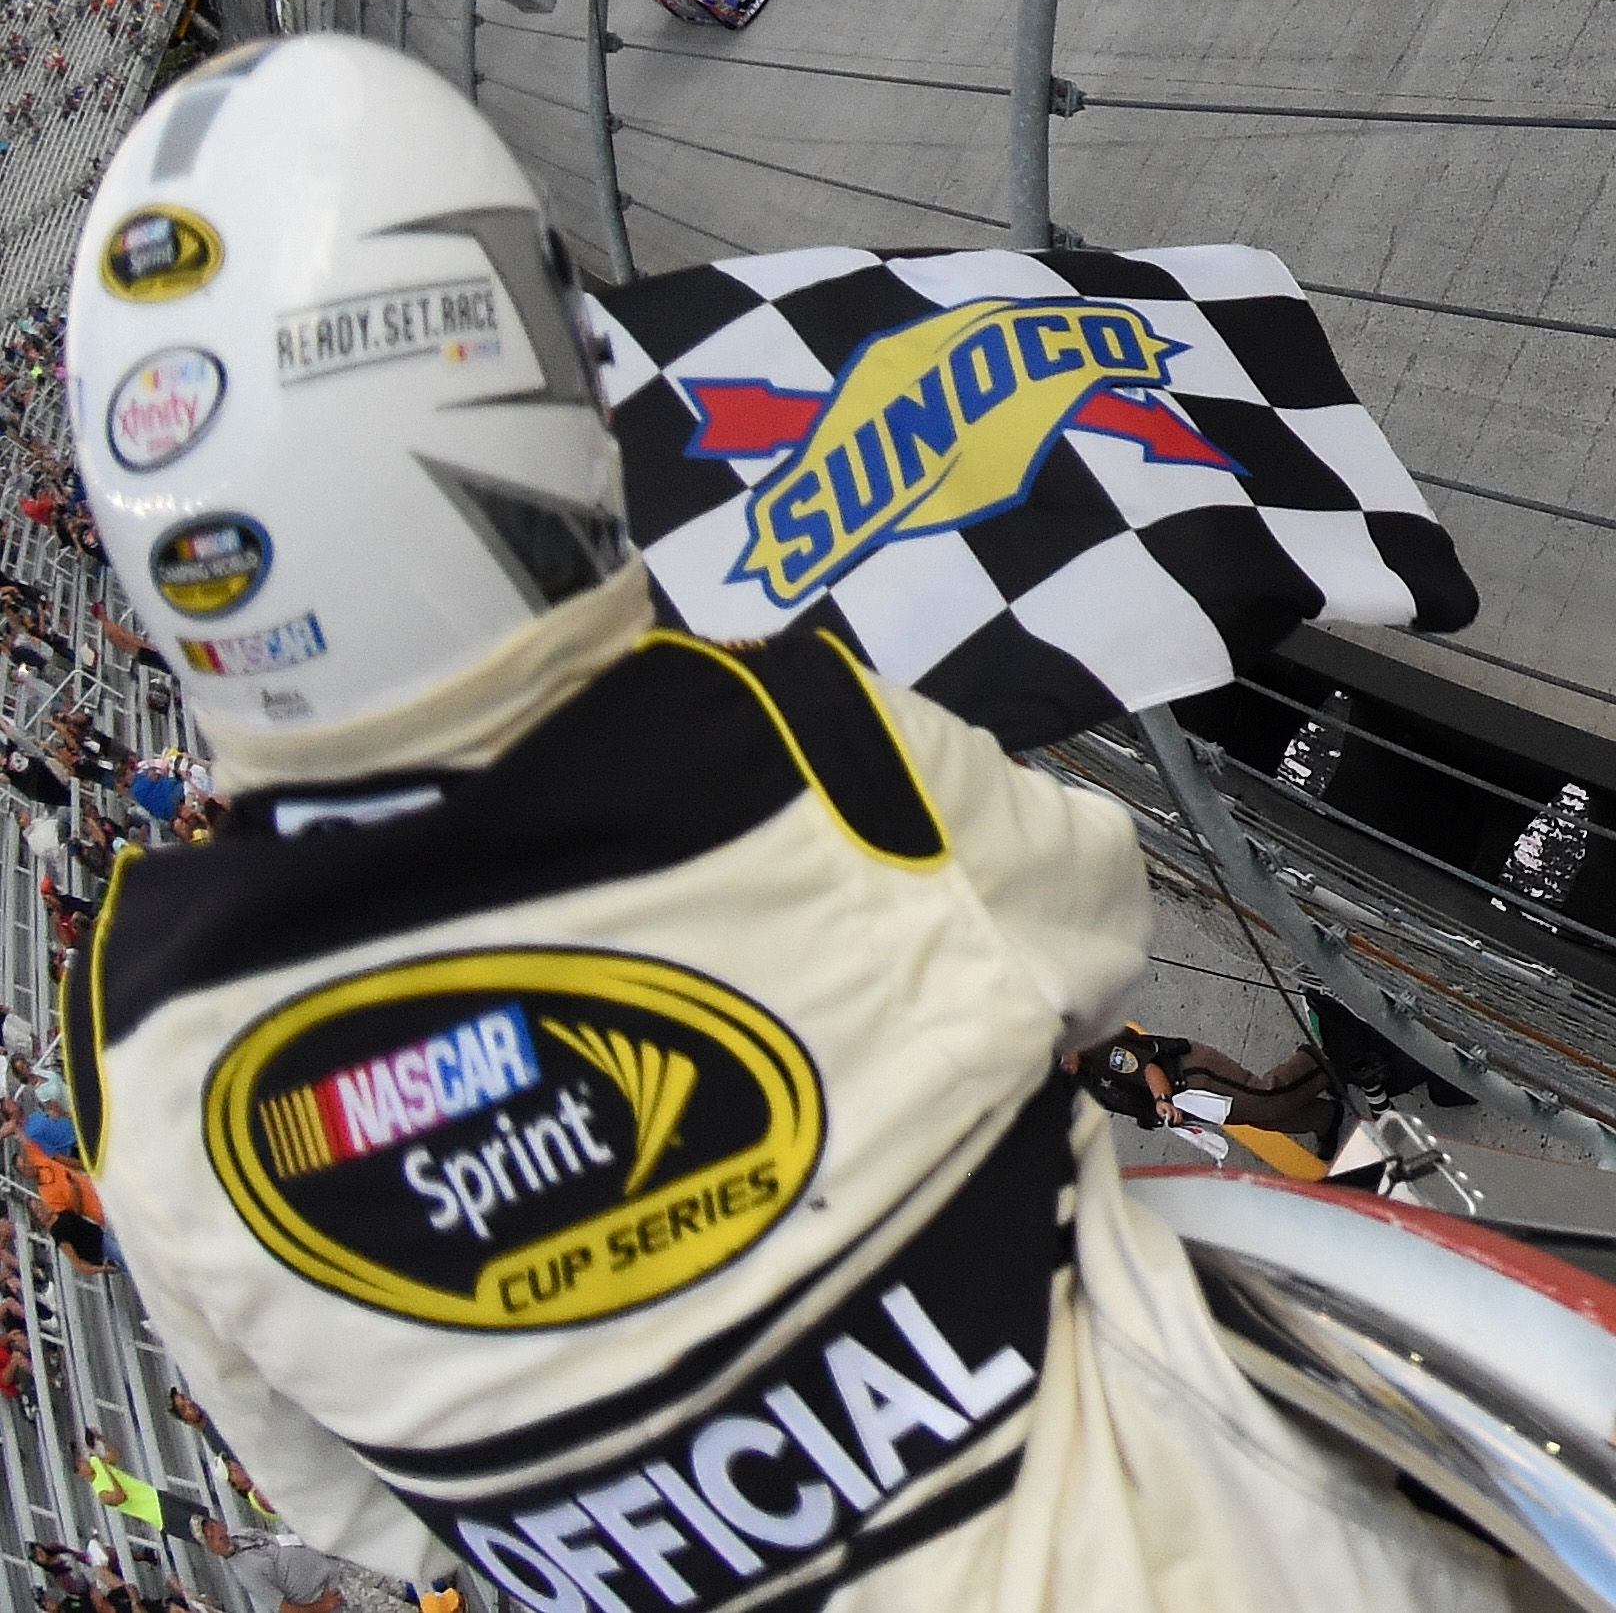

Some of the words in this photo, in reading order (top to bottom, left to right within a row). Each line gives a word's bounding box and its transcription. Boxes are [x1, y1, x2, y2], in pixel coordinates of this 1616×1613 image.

[768, 313, 1148, 582] SUNOCO
[338, 1013, 532, 1154] NASCAR
[405, 1085, 615, 1242] Sprint
[498, 1244, 595, 1317] CUP
[607, 1158, 783, 1274] SERIES
[457, 1283, 1037, 1613] OFFICIAL
